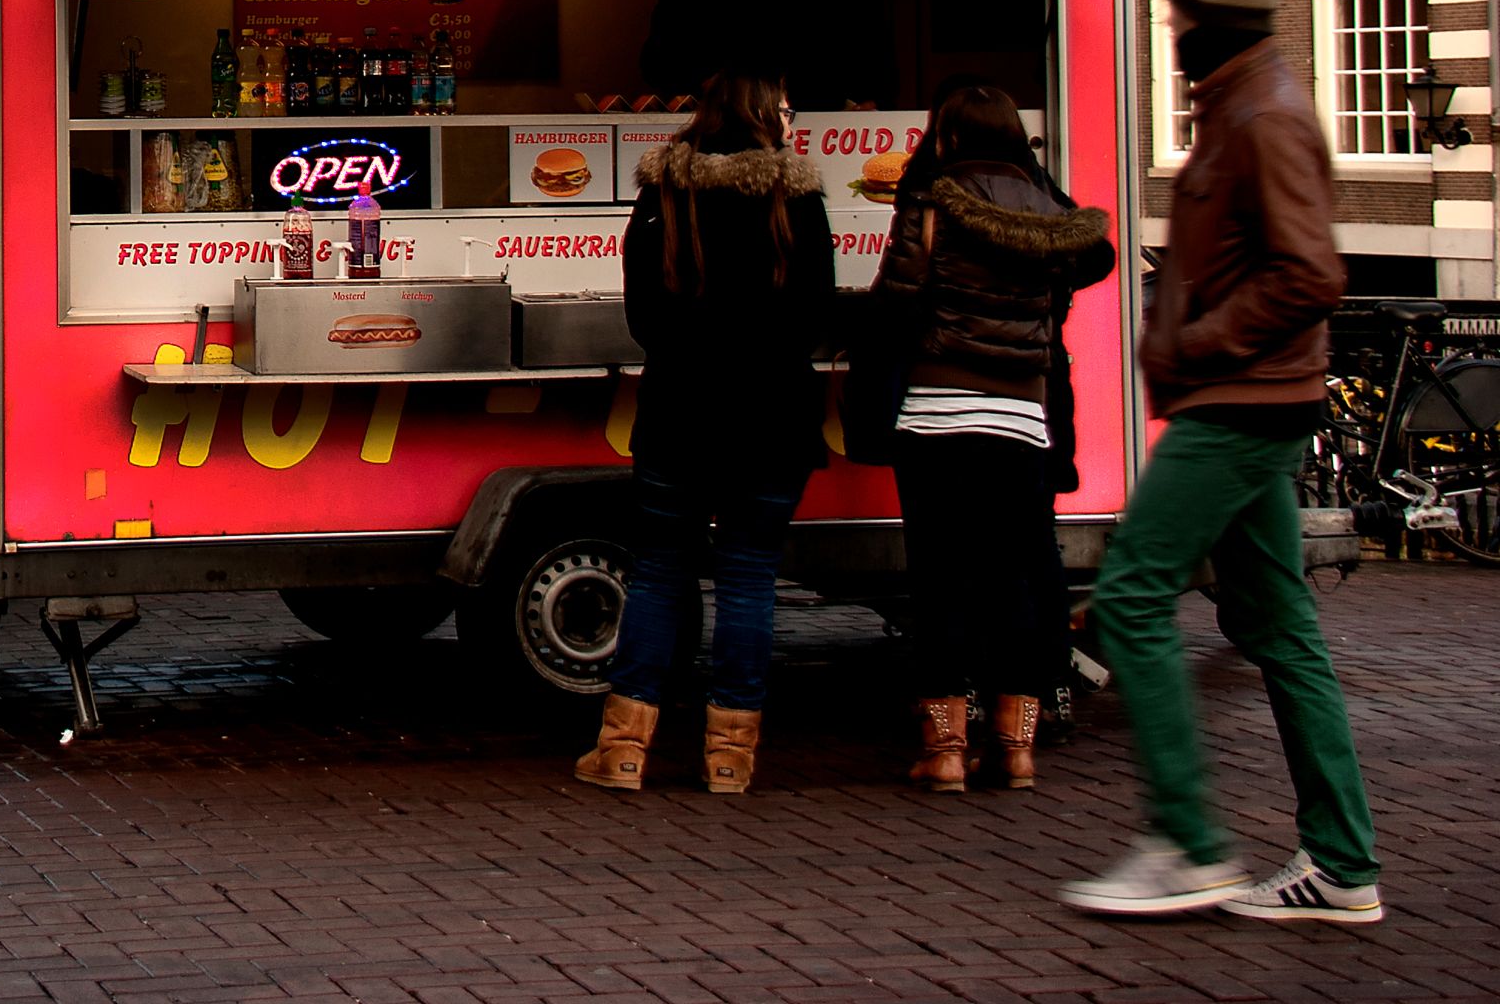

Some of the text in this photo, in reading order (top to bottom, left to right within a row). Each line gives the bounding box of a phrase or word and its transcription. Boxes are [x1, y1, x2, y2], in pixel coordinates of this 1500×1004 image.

[245, 14, 320, 27] Hamburger
[515, 132, 608, 145] HAMBURGER
[821, 128, 894, 155] COLD
[269, 154, 402, 195] OPEN
[118, 243, 179, 266] FREE
[316, 239, 332, 262] &
[332, 290, 435, 303] Mosterd ketchup
